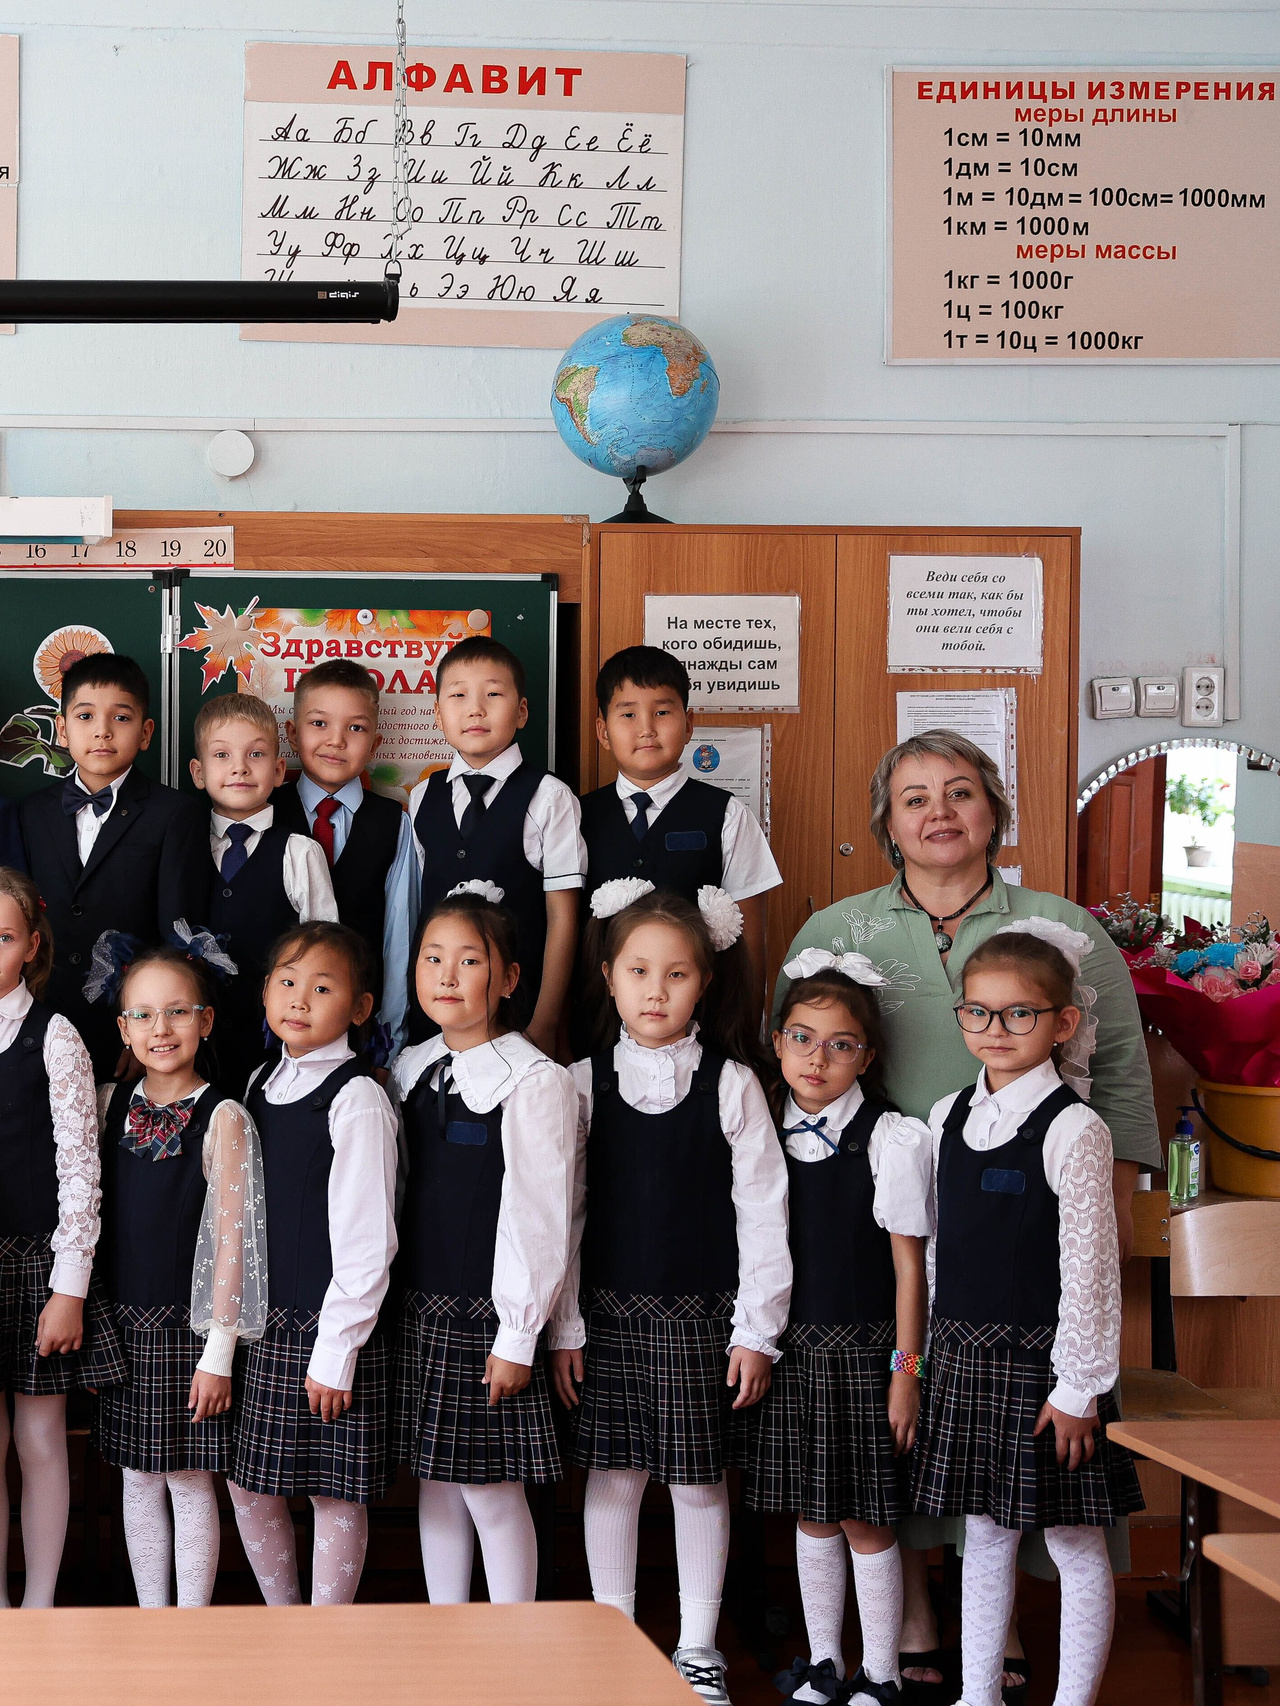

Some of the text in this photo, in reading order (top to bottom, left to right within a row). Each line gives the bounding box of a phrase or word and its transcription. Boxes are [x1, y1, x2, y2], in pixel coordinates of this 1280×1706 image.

[327, 60, 582, 97] АЛФАВИТ
[918, 81, 1275, 104] ЕДИНИЦЫ ИЗМЕРЕНИЯ
[1015, 107, 1177, 128] меры длины
[271, 113, 311, 143] Аа
[334, 117, 378, 144] Бб
[454, 122, 481, 148] Гг
[502, 123, 547, 161] Дд
[564, 126, 600, 152] Ее
[617, 123, 653, 154] Ёё
[943, 127, 988, 147] 1см
[1018, 125, 1081, 148] 10мм
[267, 155, 328, 181] Жж
[470, 154, 515, 186] Йй
[537, 163, 584, 188] Кк
[606, 165, 657, 191] Лл
[943, 157, 990, 180] 1дм
[1020, 157, 1078, 177] 10см
[943, 186, 973, 206] 1м
[1005, 186, 1064, 210] 10дм
[1088, 187, 1174, 208] 100см=
[1178, 187, 1266, 209] 1000мм
[261, 194, 319, 219] Мм
[334, 194, 376, 221] Нн
[438, 197, 486, 226] Пп
[502, 196, 540, 229] Рр
[557, 203, 587, 228] Сс
[606, 202, 663, 231] Тт
[943, 216, 986, 236] 1км
[1016, 215, 1089, 236] 1000м
[267, 229, 301, 268] Уу
[322, 231, 361, 262] Фф
[444, 235, 490, 265] Цц
[510, 236, 554, 264] Чч
[577, 239, 639, 267] Шш
[1016, 243, 1177, 263] меры массы
[438, 273, 469, 299] Ээ
[487, 275, 536, 302] Юю
[553, 275, 603, 304] Яя
[944, 269, 980, 290] 1кг
[1009, 270, 1074, 290] 1000г
[329, 291, 360, 299] digis
[943, 299, 971, 323] 1ц
[1001, 299, 1065, 320] 100кг
[943, 329, 968, 349] 1т
[996, 330, 1038, 354] 10ц
[1067, 330, 1144, 350] 1000кг
[25, 544, 47, 559] 16
[70, 544, 90, 558] 17
[116, 540, 137, 558] 18
[160, 540, 181, 558] 19
[203, 539, 227, 558] 20
[925, 570, 1006, 583] Веди себя со
[906, 589, 1024, 602] всеми так, как бы
[906, 606, 1023, 618] ты хотел, чтобы
[667, 616, 776, 631] На месте тех,
[915, 623, 1014, 635] они вели себя с
[662, 636, 781, 652] кого обидишь,
[941, 639, 986, 651] тобой.
[748, 659, 778, 670] сам
[706, 680, 781, 695] увидишь
[400, 706, 417, 715] год
[377, 720, 429, 730] адостного
[398, 750, 454, 760] мгновений
